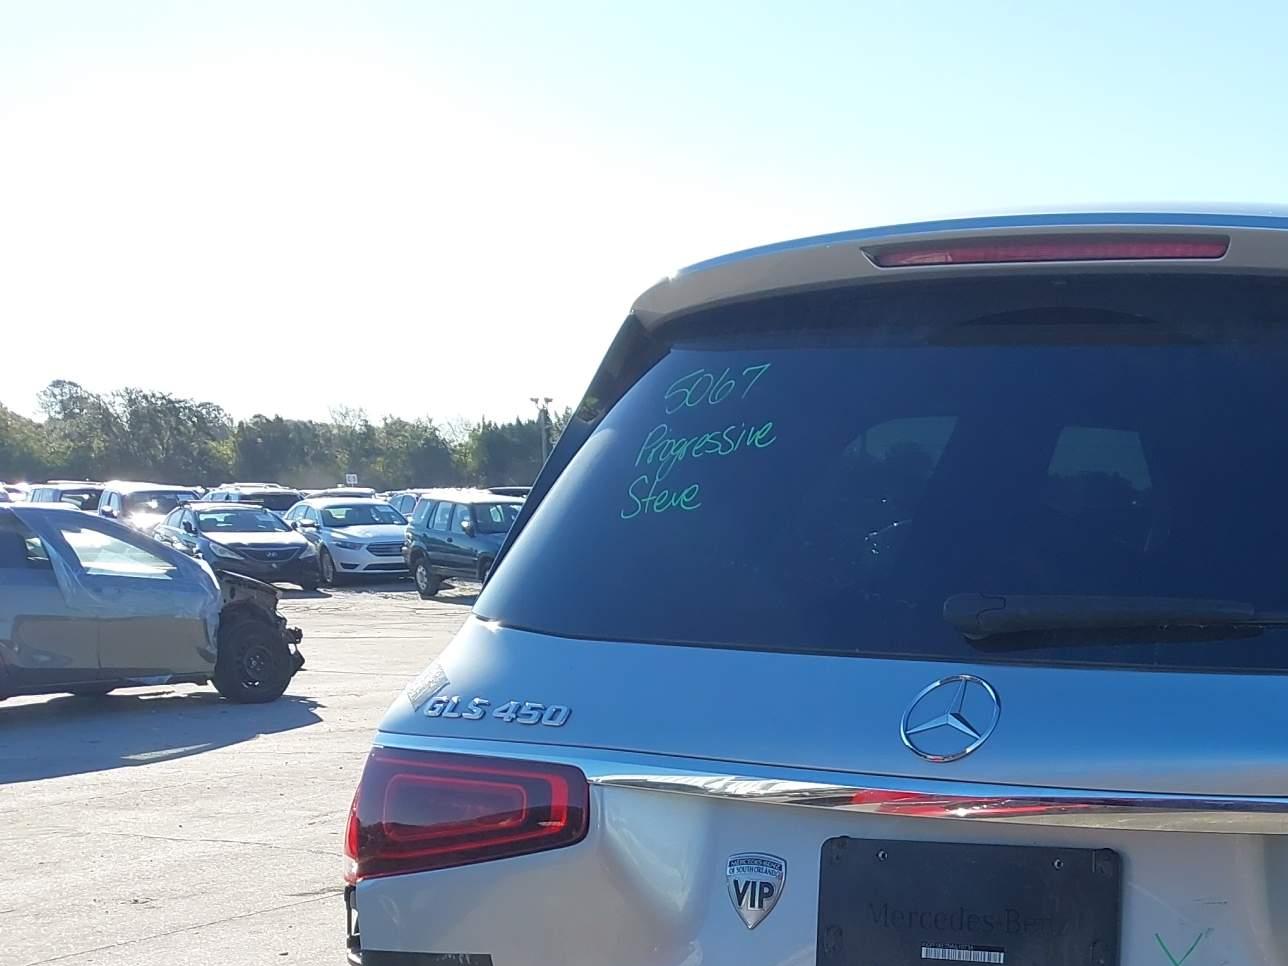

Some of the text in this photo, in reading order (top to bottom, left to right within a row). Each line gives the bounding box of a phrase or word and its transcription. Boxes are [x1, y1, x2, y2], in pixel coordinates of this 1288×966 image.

[664, 363, 771, 414] 5067
[634, 422, 777, 482] Progressive
[620, 475, 702, 519] Steve
[423, 695, 572, 727] GLS 450
[733, 879, 775, 909] VIP
